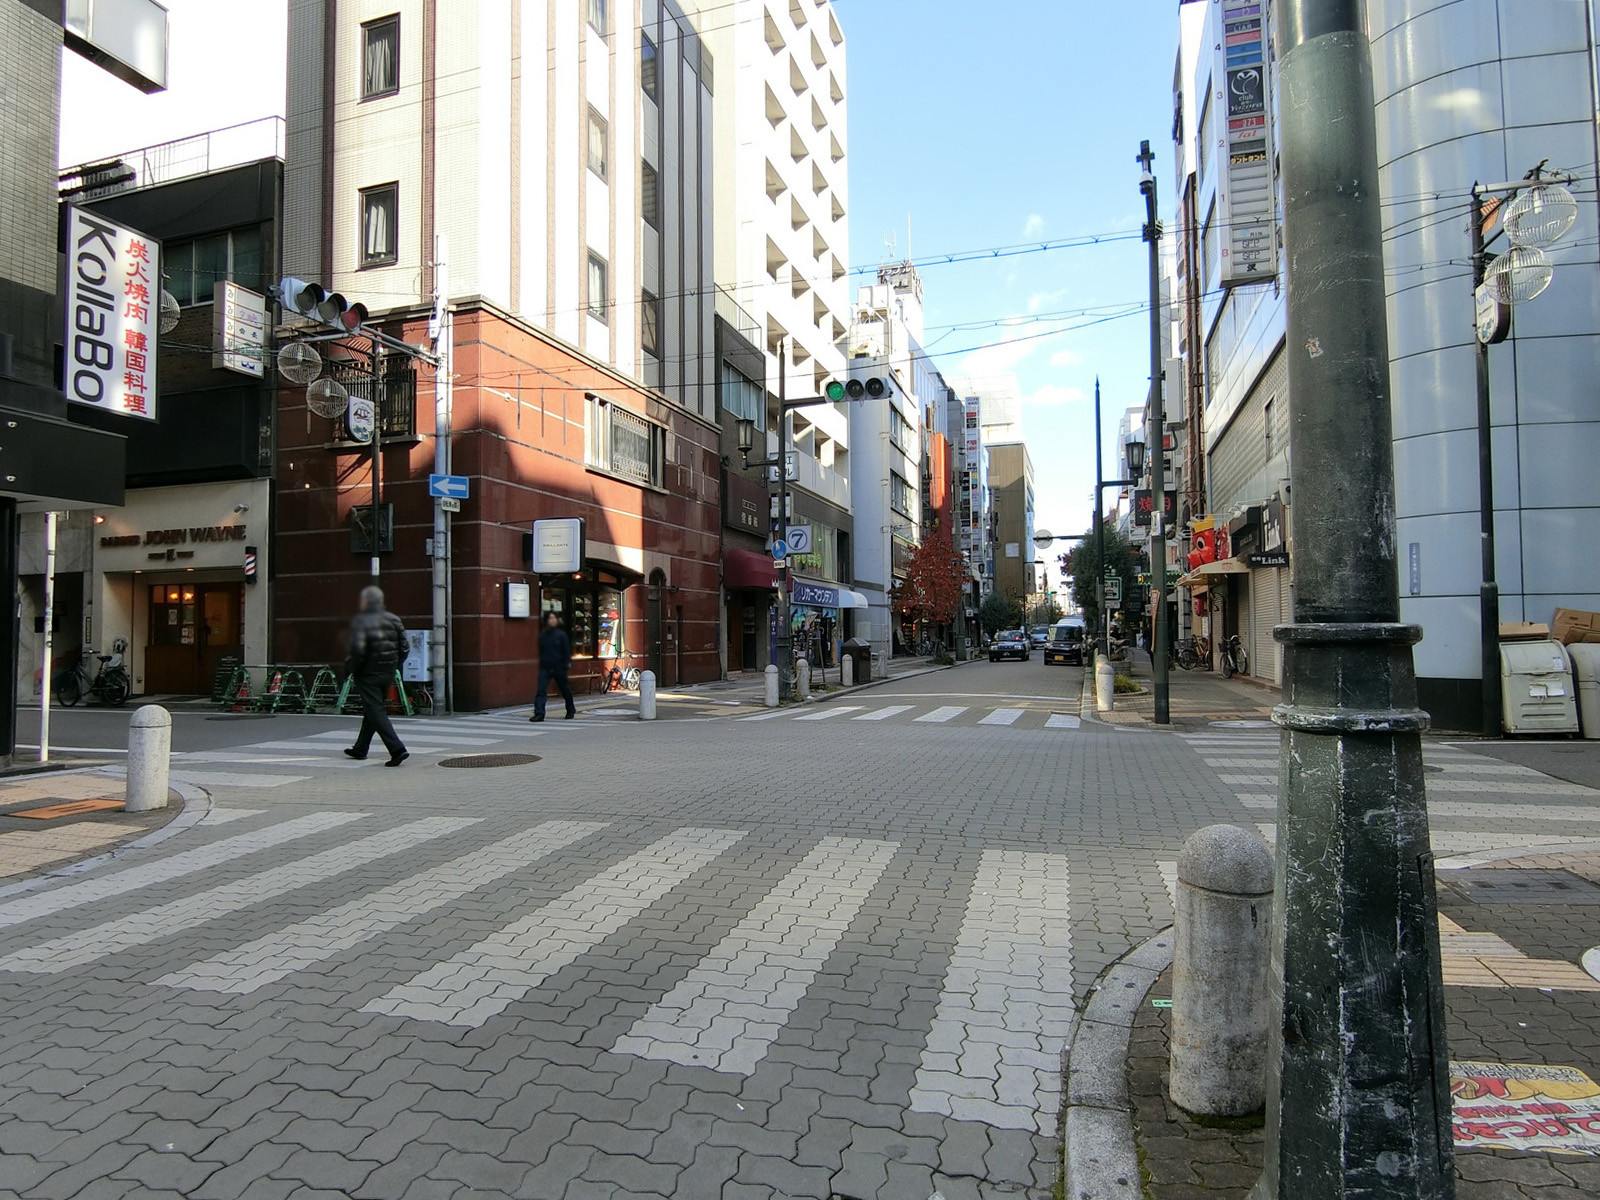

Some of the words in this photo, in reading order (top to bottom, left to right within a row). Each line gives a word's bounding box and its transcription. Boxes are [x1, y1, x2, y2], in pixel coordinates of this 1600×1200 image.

[74, 213, 118, 403] KollaBo
[124, 238, 151, 324] 炭火焼肉
[123, 328, 149, 415] 韓国料理
[143, 529, 187, 545] JOHN
[189, 525, 246, 543] WAYNE
[792, 533, 804, 548] 7
